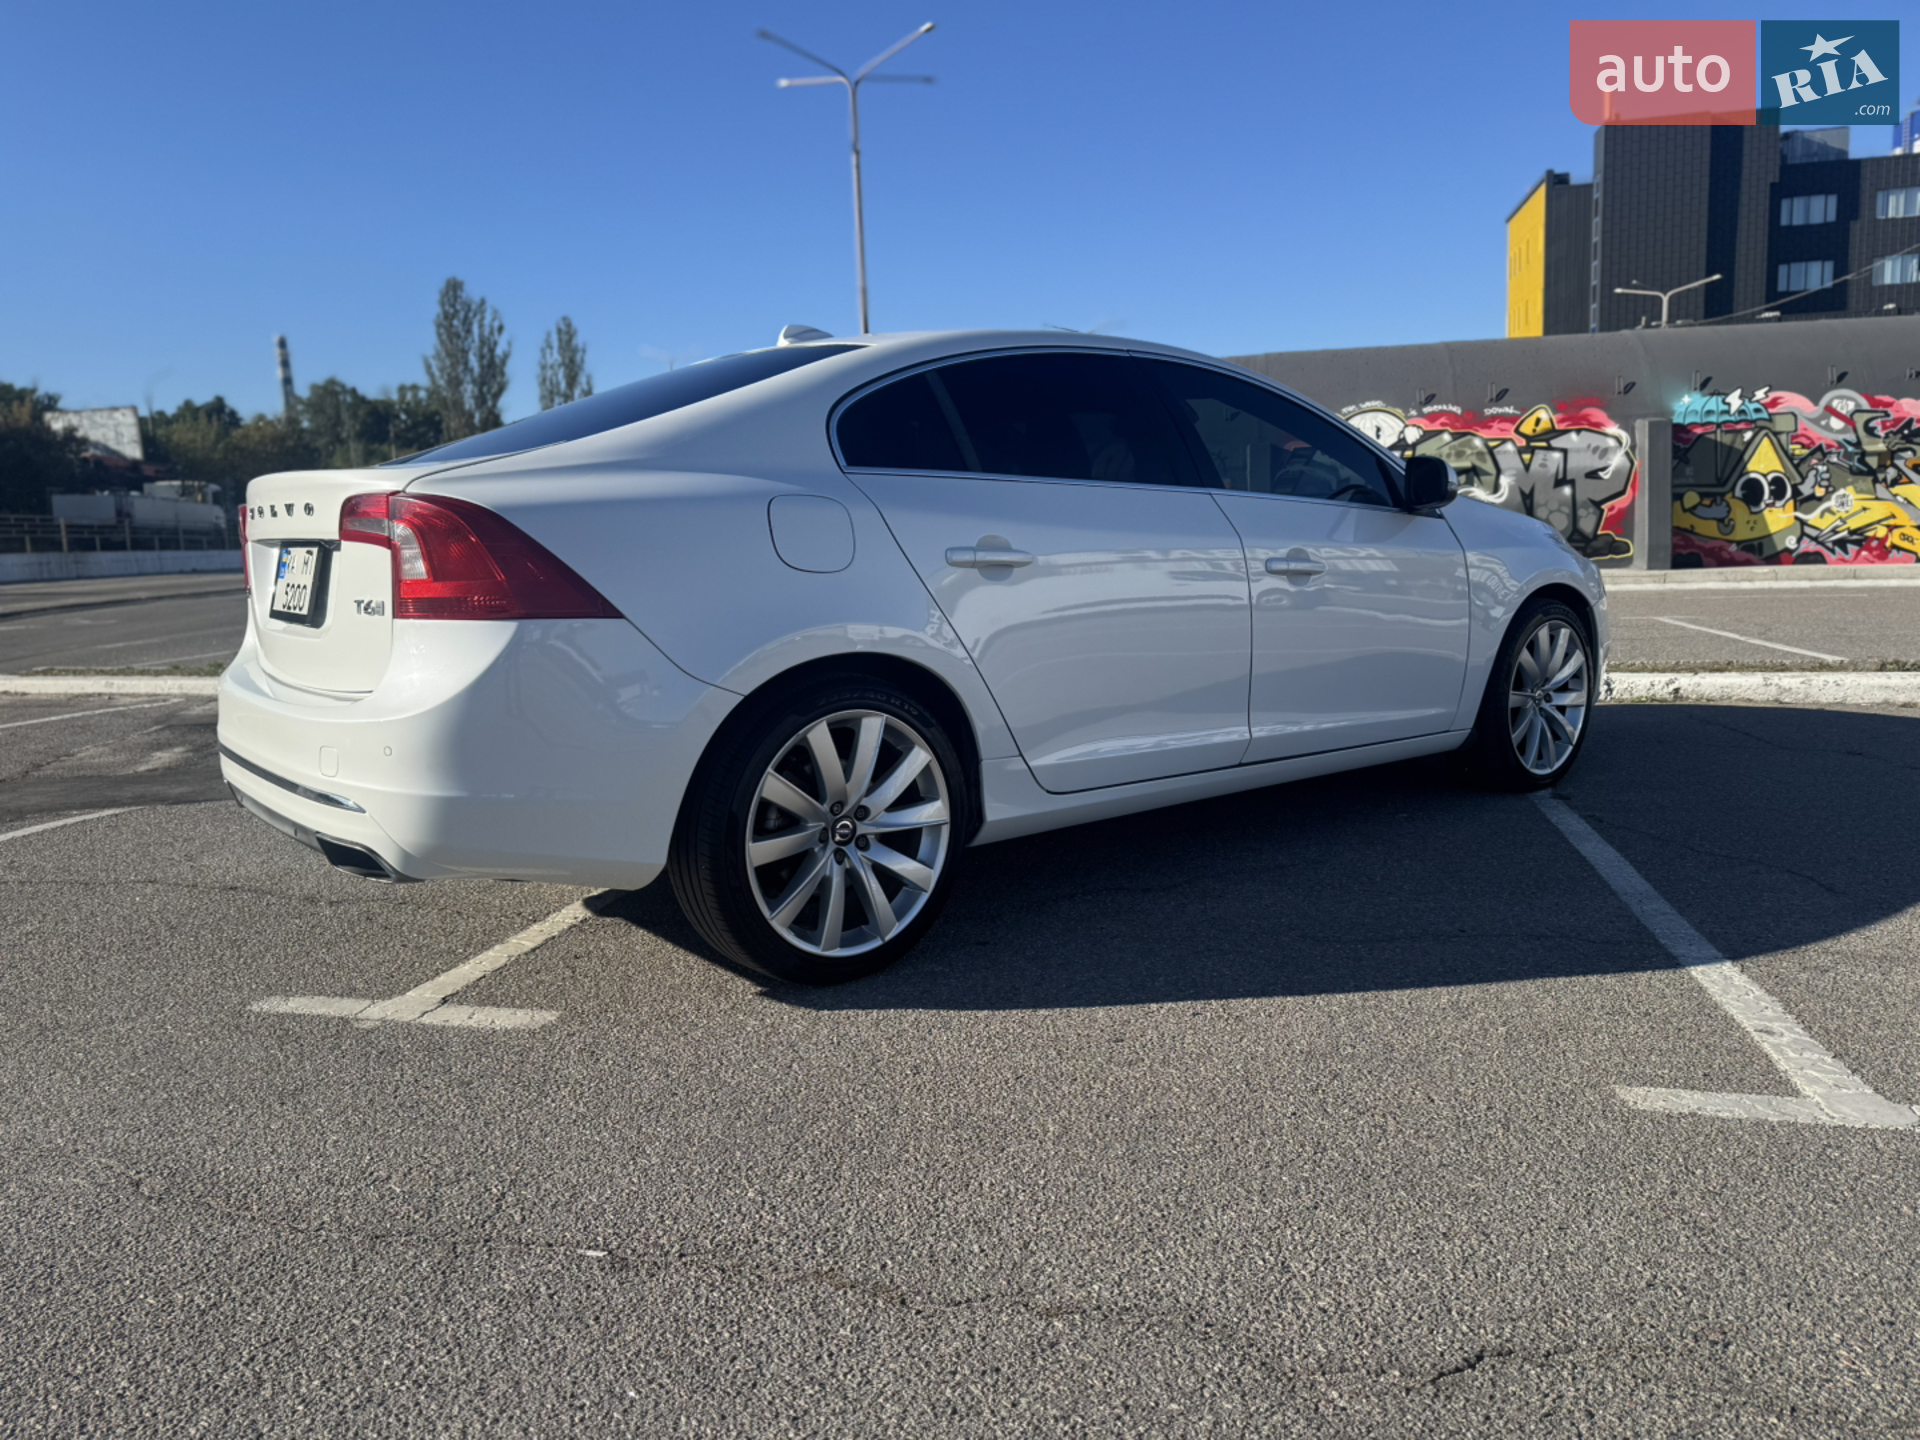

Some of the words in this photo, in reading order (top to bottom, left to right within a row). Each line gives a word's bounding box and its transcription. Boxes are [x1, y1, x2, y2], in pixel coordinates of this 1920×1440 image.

[249, 502, 314, 520] VOLVO
[282, 582, 307, 612] 5200
[353, 599, 376, 616] T6
